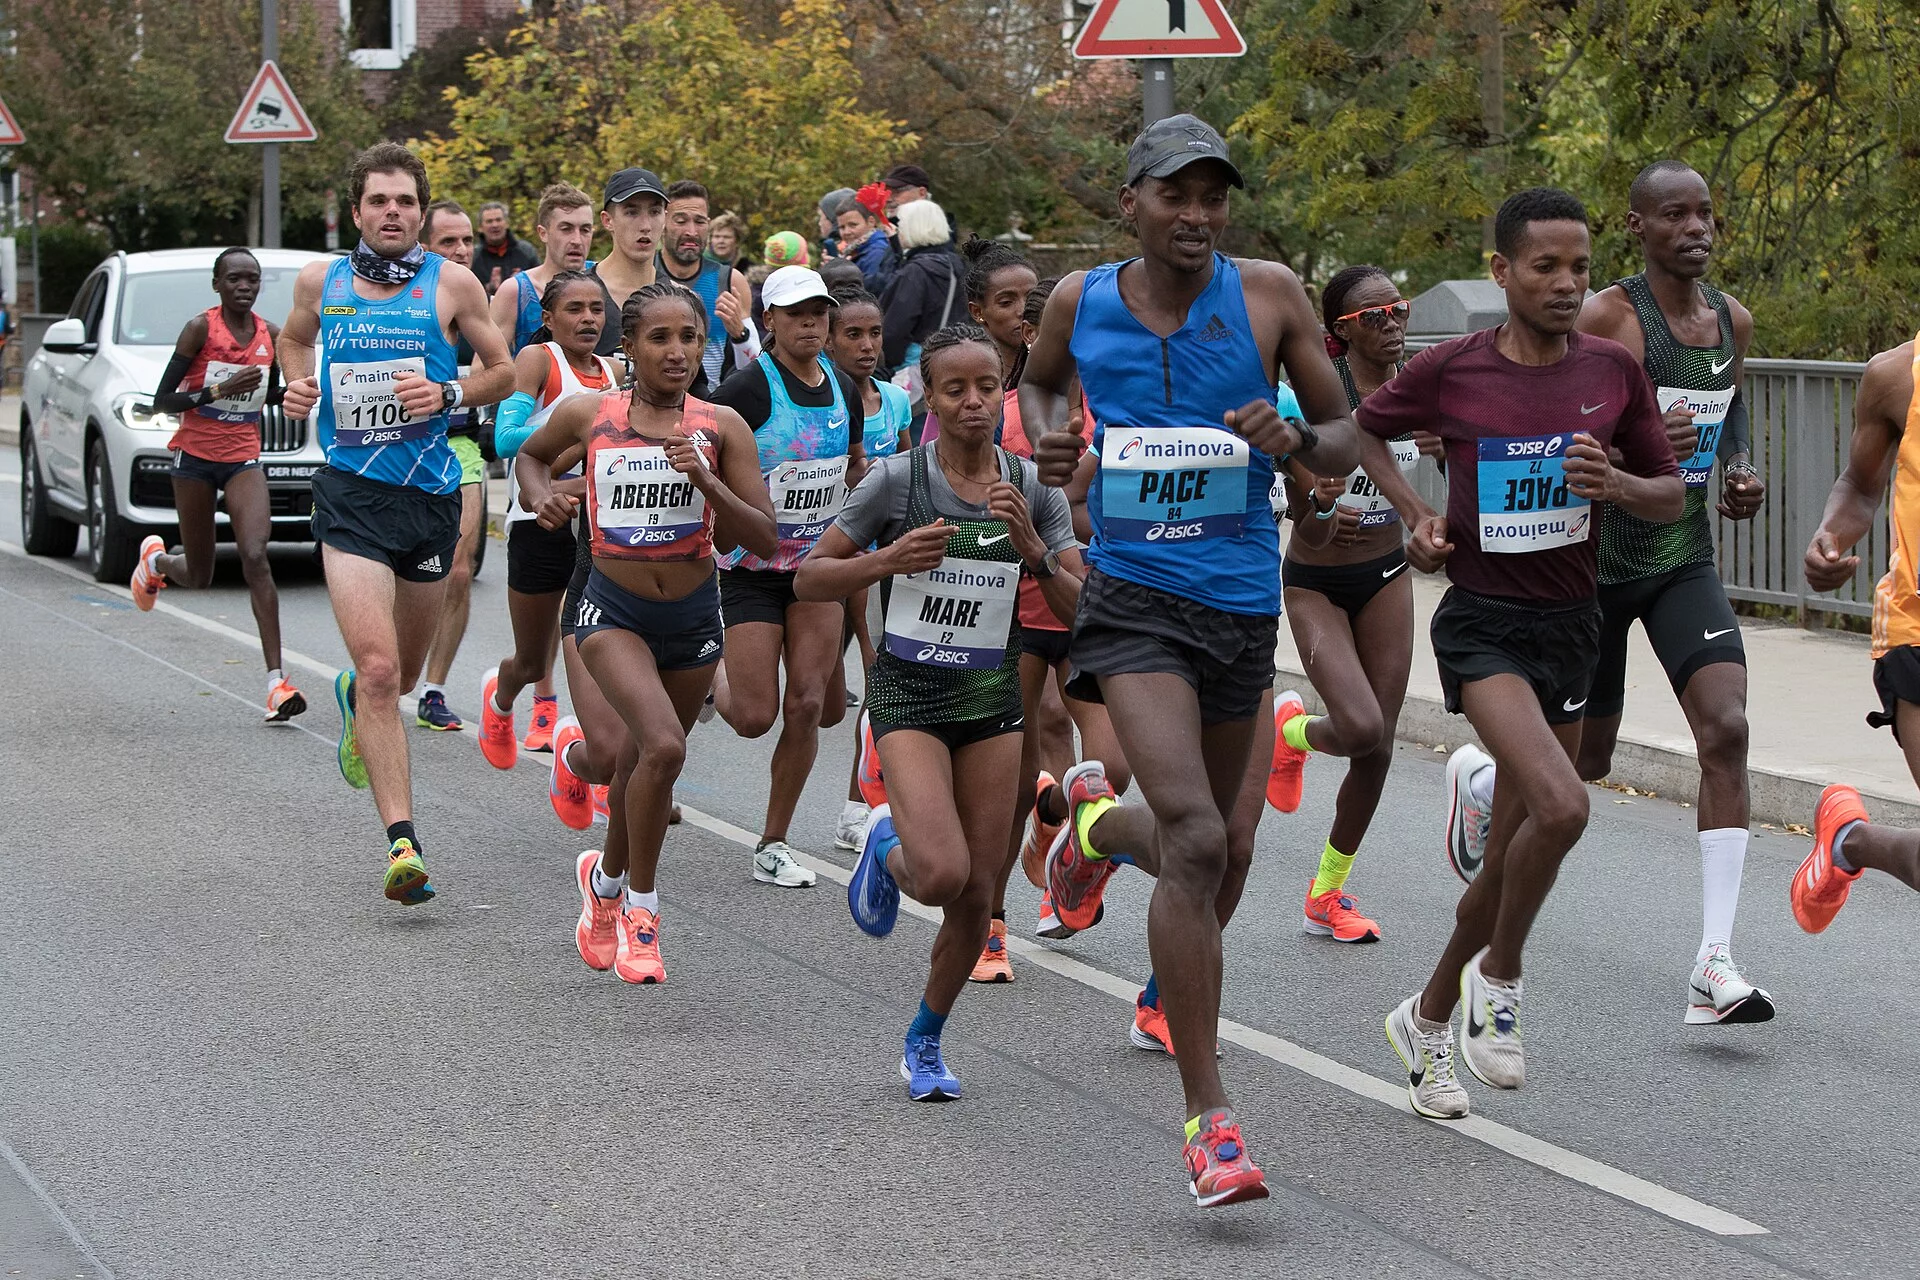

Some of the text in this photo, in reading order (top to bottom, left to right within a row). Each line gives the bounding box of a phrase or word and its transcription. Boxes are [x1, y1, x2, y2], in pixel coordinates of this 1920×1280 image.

[349, 323, 425, 336] LAV Stadtwerke
[349, 336, 425, 351] TÜBINGEN
[355, 369, 415, 383] maino
[361, 394, 395, 403] Lorenz
[351, 404, 412, 428] 1106
[374, 430, 402, 442] asics
[1145, 440, 1234, 457] mainova
[1507, 441, 1545, 456] asics
[628, 456, 669, 471] main
[1529, 461, 1542, 474] 72
[268, 467, 290, 477] DER
[797, 465, 843, 480] mainova
[1684, 471, 1707, 483] asics
[1138, 470, 1210, 504] PACE
[1504, 475, 1569, 512] PACE
[610, 482, 695, 510] ABEBECH
[648, 514, 659, 525] F9
[1167, 507, 1182, 520] 84
[1363, 513, 1387, 525] asics
[645, 530, 676, 542] asics
[804, 524, 825, 536] asics
[1164, 522, 1203, 539] asics
[1484, 521, 1566, 541] mainova
[417, 563, 443, 573] adidas
[928, 569, 1006, 588] mainova
[918, 595, 983, 628] MARE
[940, 631, 954, 645] F2
[934, 650, 970, 664] asics
